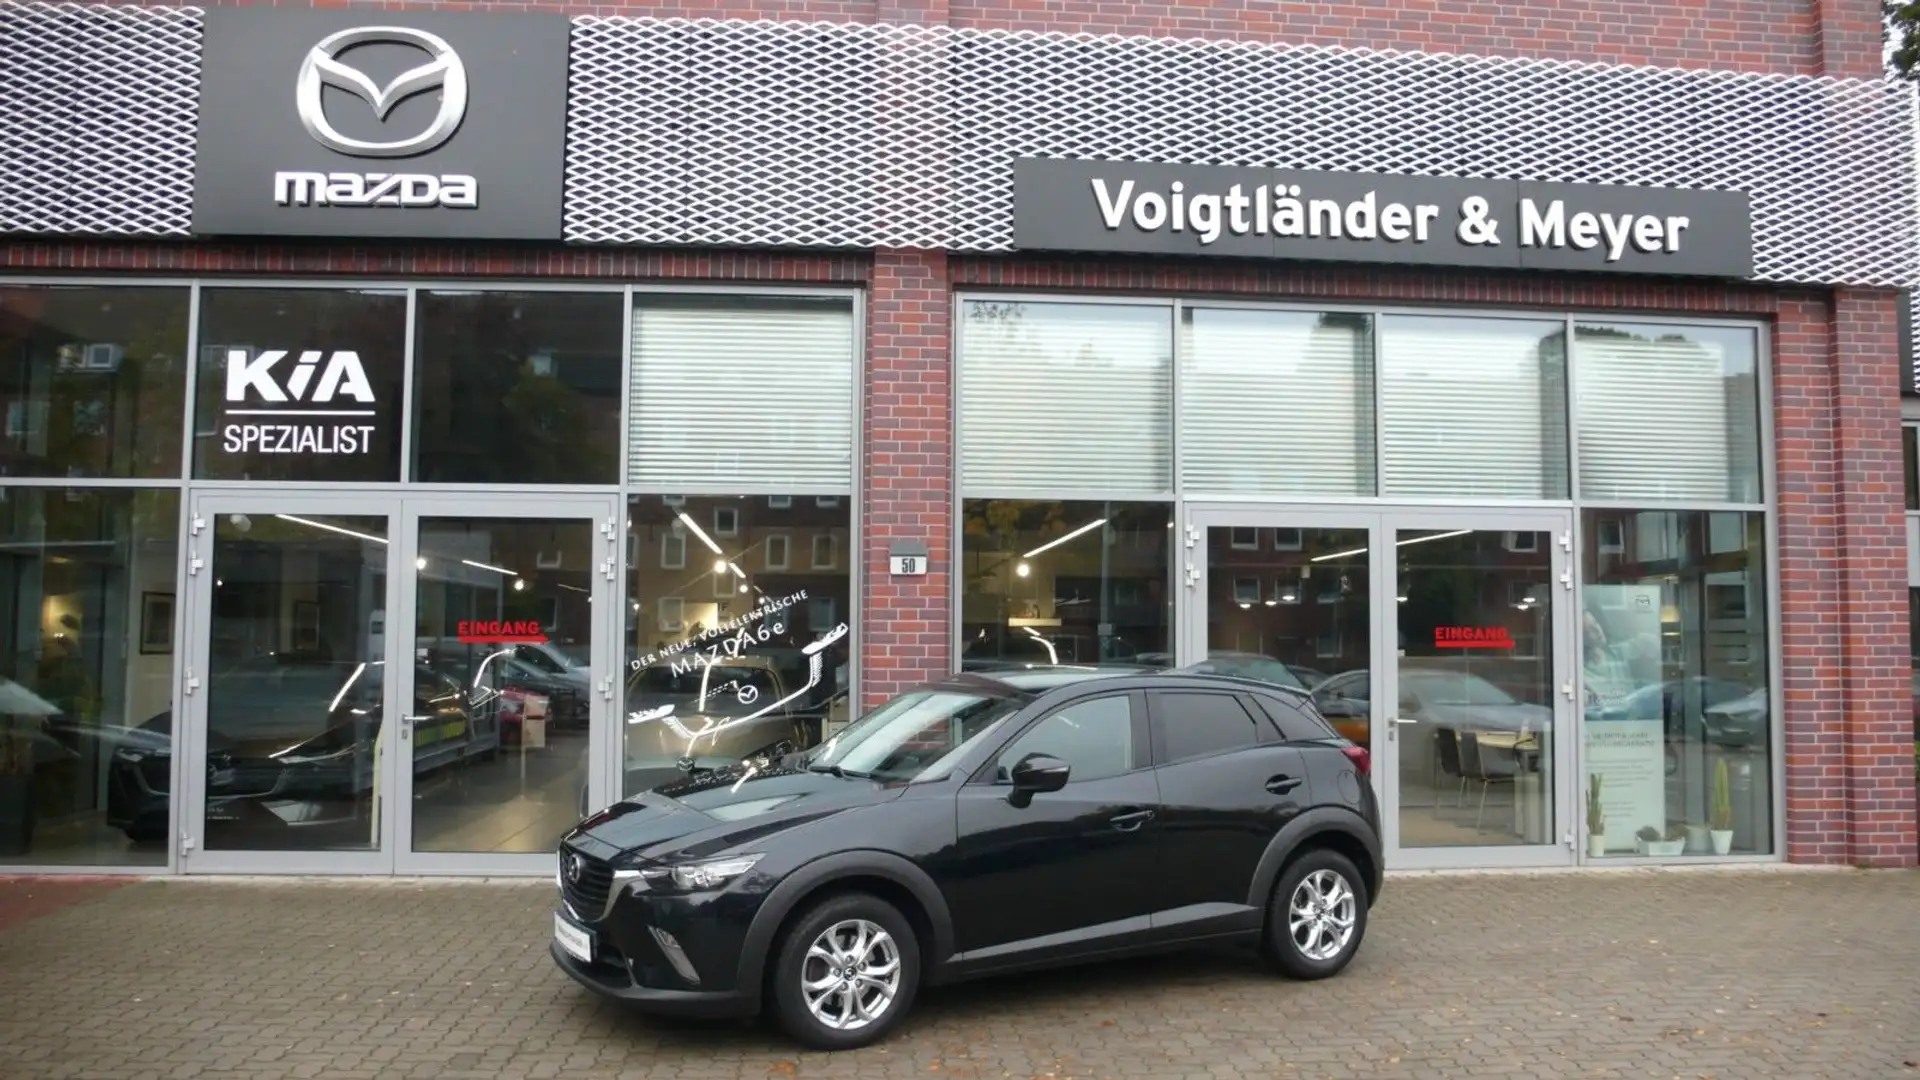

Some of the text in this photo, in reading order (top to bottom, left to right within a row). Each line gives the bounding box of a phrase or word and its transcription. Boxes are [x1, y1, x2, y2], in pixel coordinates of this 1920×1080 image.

[1091, 178, 1689, 261] Voigtländer & Meyer
[223, 424, 375, 454] SPEZIALIST
[901, 557, 916, 573] 50
[458, 620, 539, 635] EINGANG
[1435, 627, 1508, 640] EINGANG
[670, 622, 785, 678] MAZDA6e
[631, 653, 656, 671] DER
